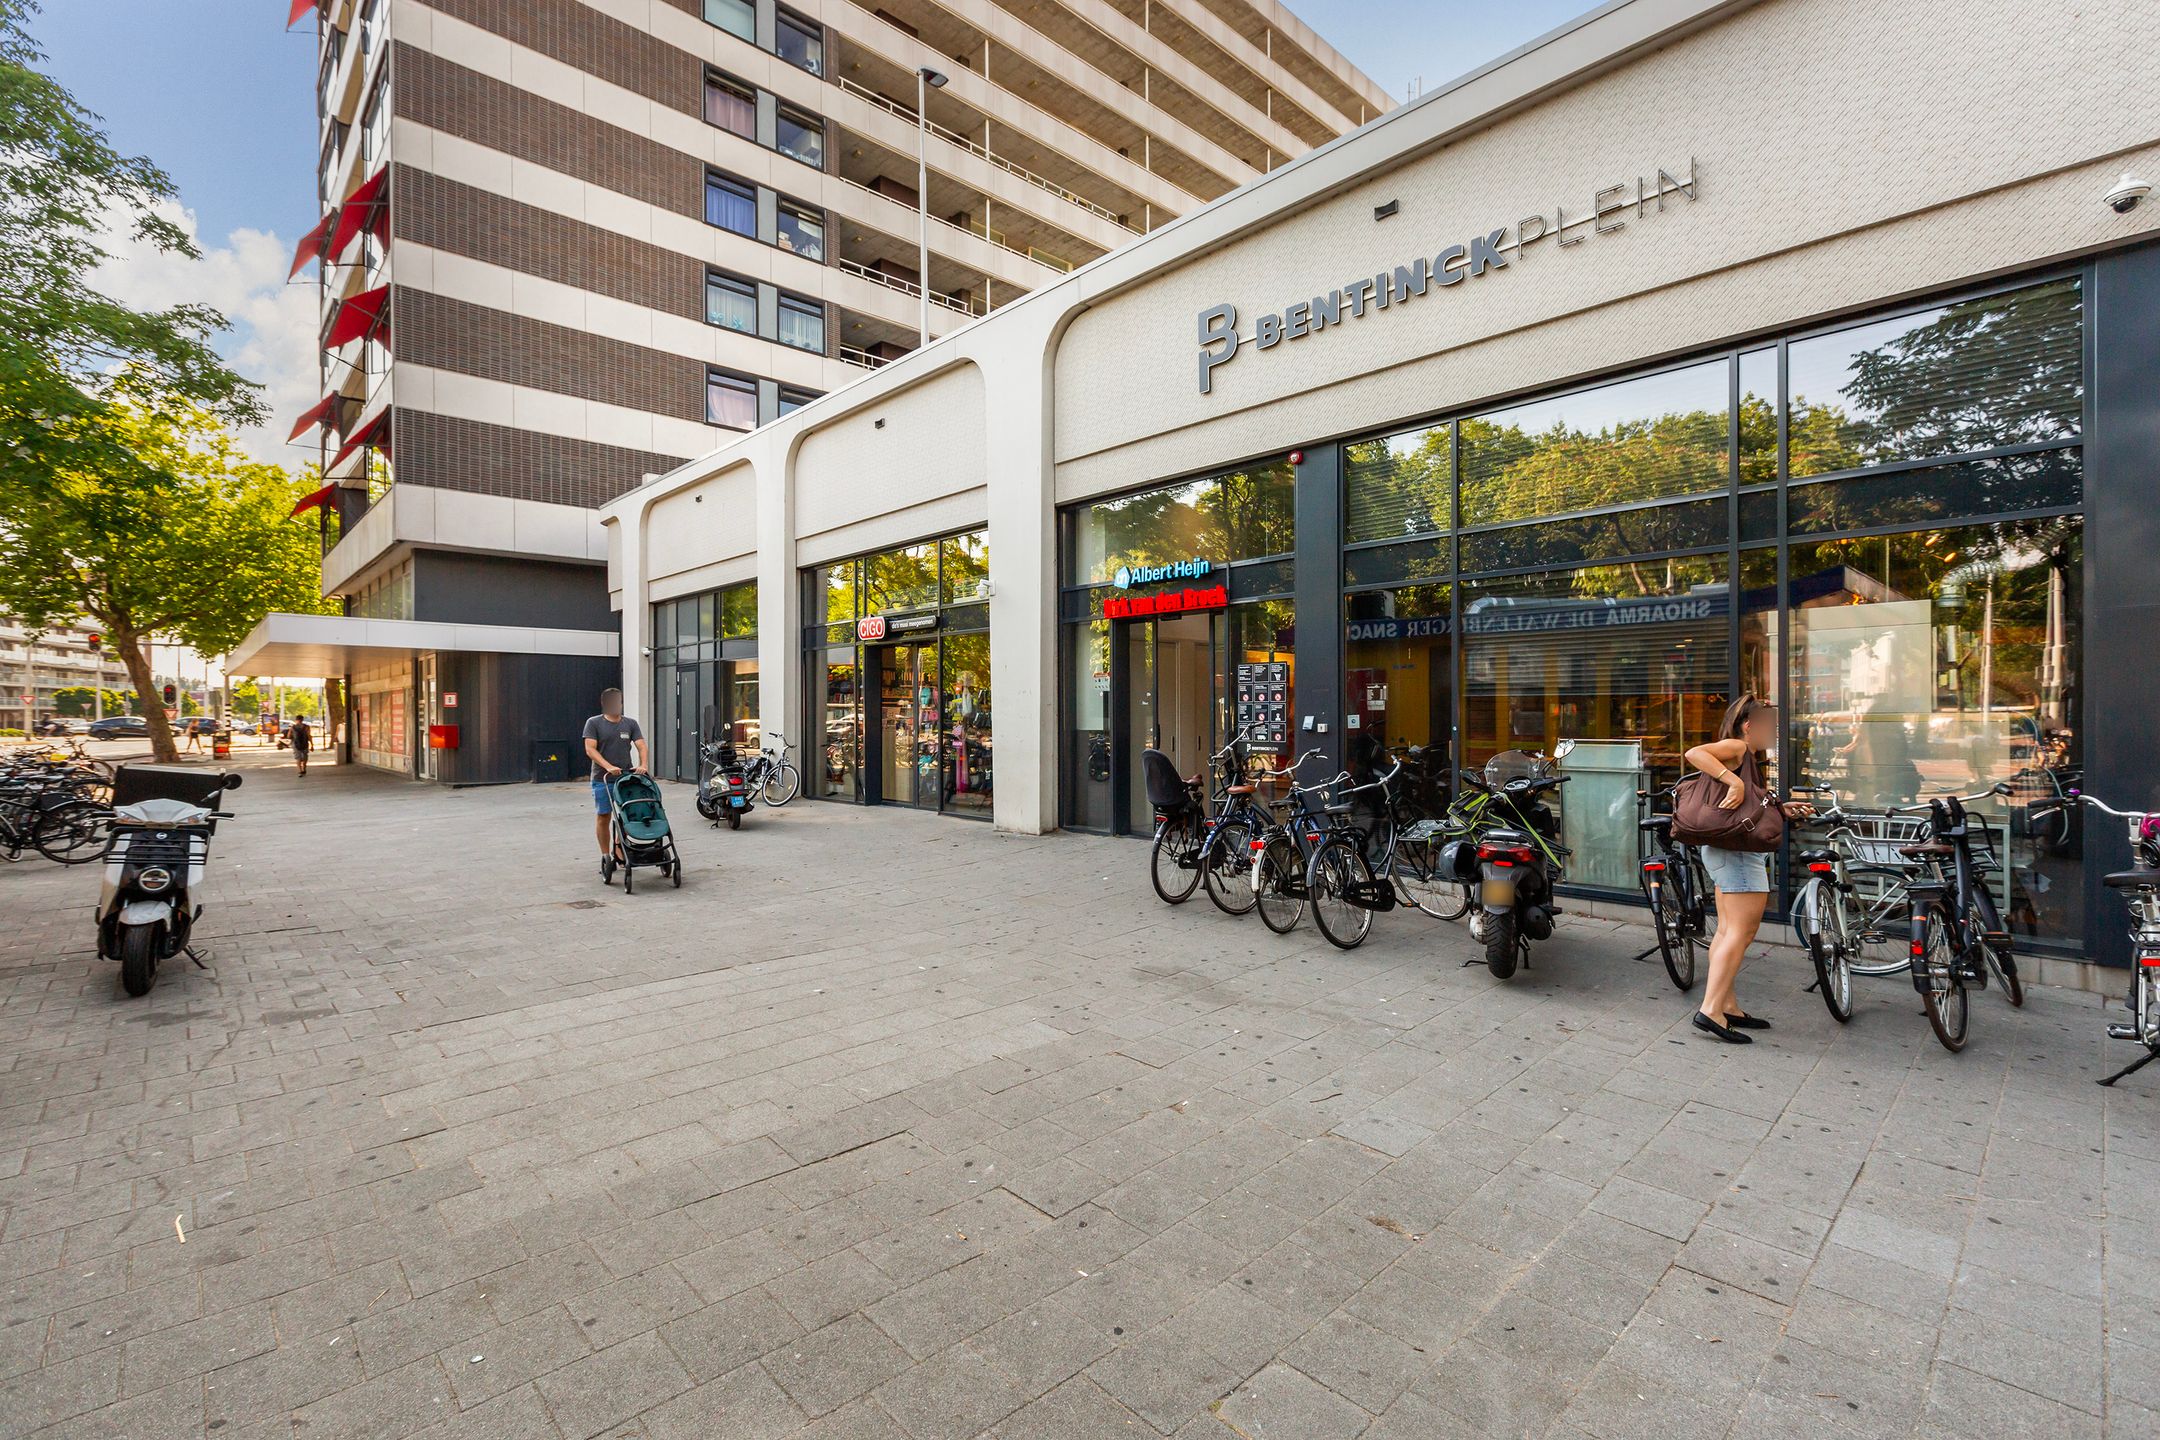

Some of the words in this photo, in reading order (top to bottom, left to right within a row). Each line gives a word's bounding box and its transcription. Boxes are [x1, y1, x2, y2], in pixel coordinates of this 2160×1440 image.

[1256, 155, 1698, 351] BENTINCKPLEIN
[1131, 565, 1173, 584] Albert
[1174, 557, 1210, 579] Heijn
[860, 619, 883, 637] CIGO
